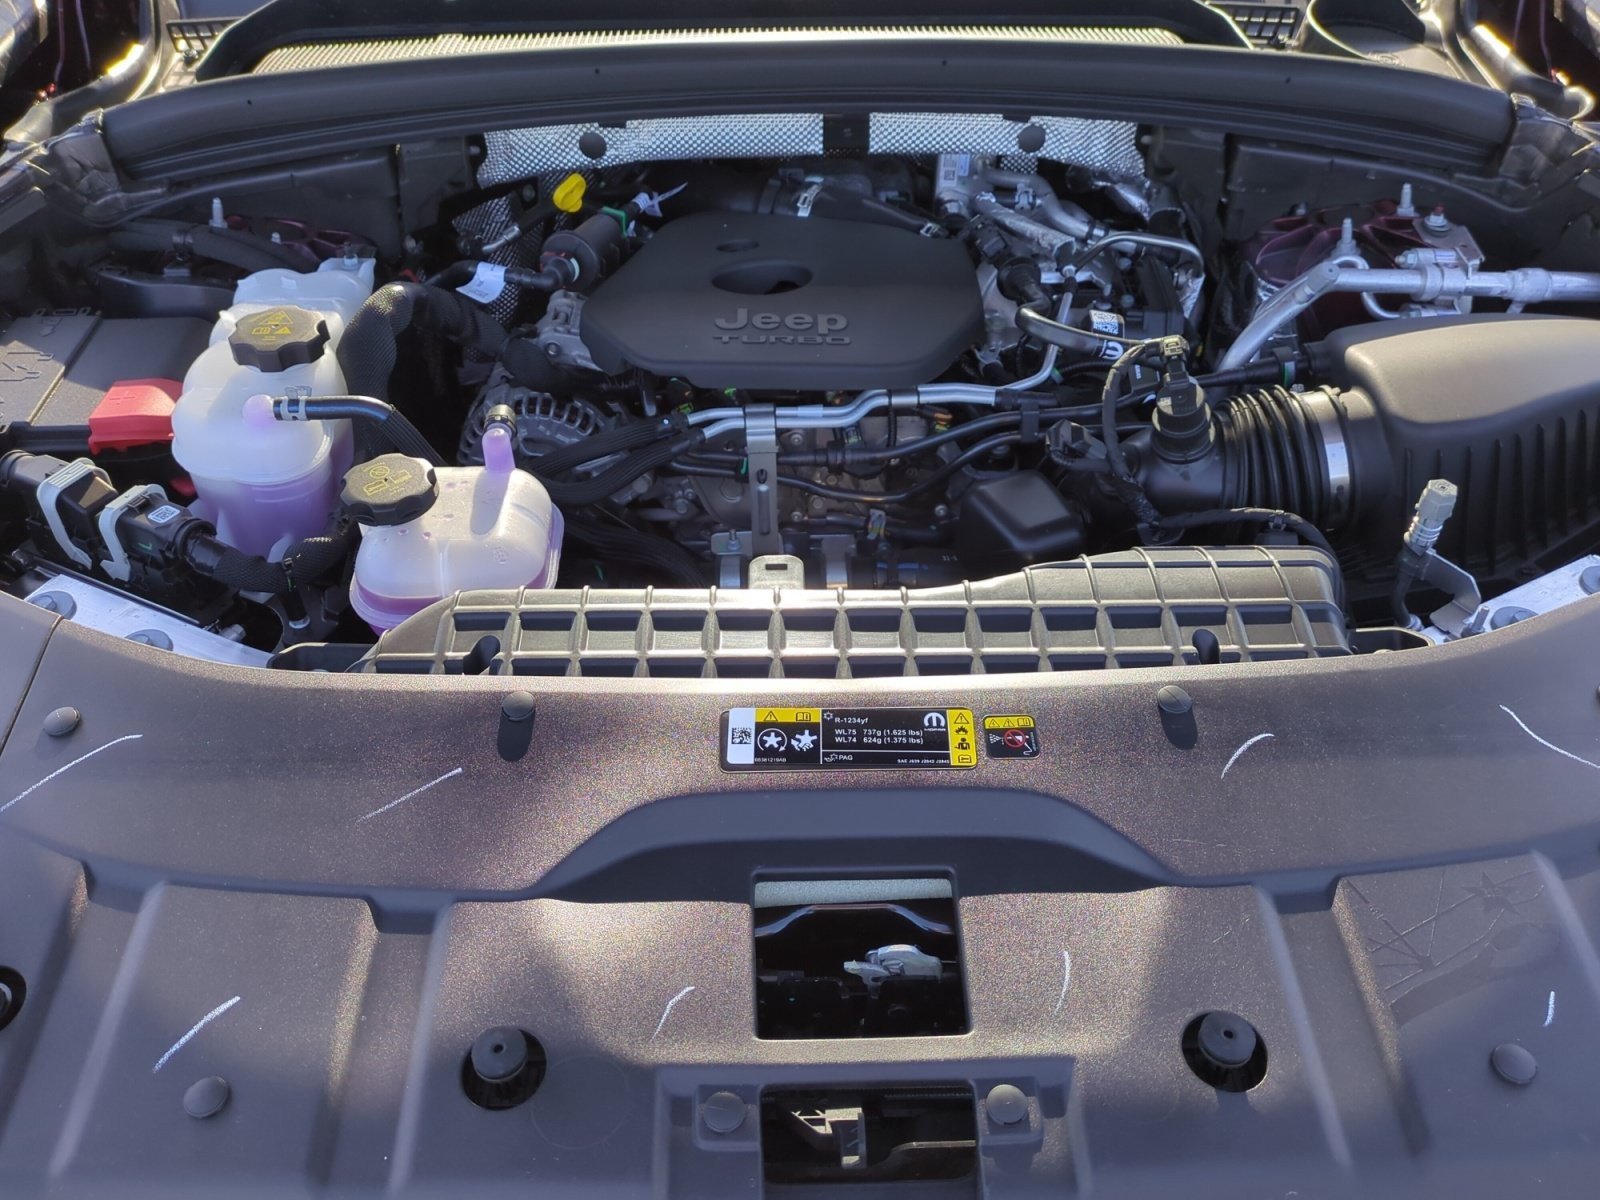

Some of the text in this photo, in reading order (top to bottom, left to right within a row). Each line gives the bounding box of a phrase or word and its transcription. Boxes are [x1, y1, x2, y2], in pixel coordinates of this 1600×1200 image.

[714, 308, 848, 335] Jeep
[712, 335, 852, 346] TURBO
[835, 717, 868, 725] R-1234yf
[908, 729, 923, 737] lbs)
